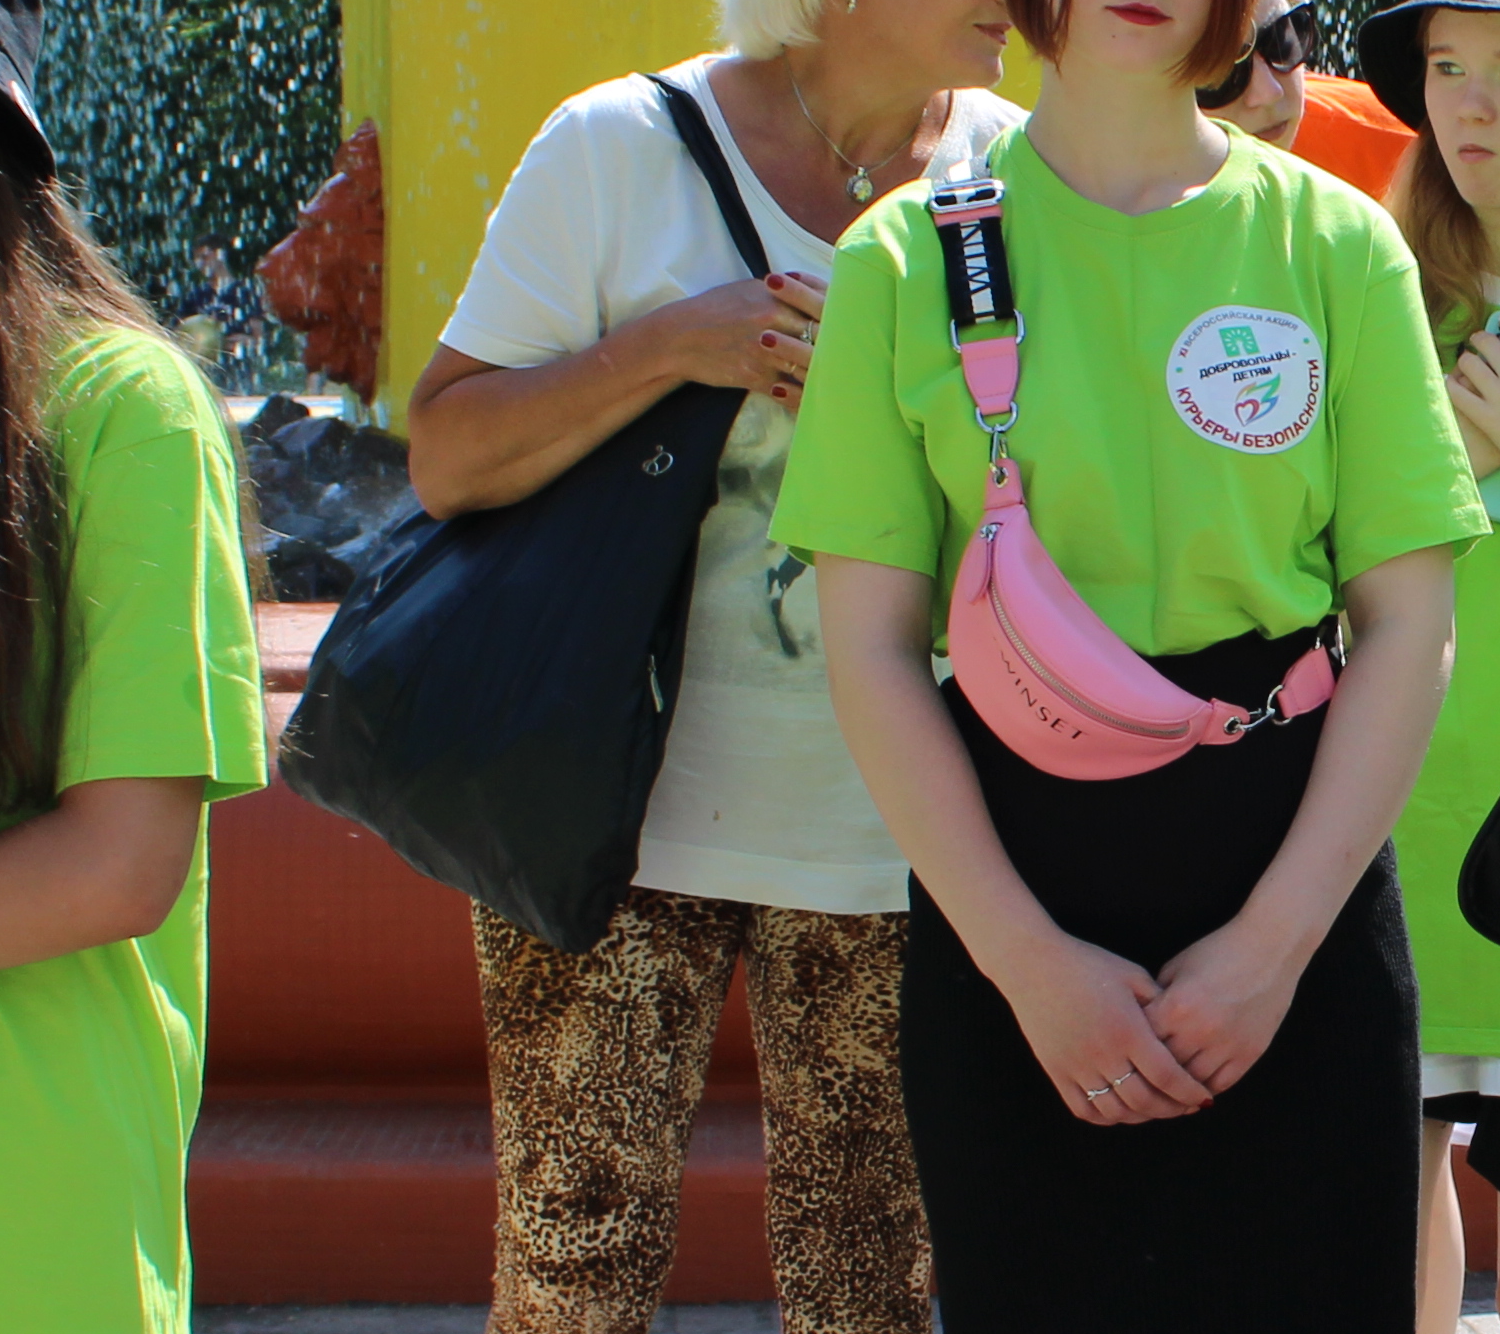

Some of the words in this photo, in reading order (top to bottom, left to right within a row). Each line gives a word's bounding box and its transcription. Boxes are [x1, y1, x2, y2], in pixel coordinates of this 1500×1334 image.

[1183, 310, 1263, 347] ВСЕРОССИЙСКАЯ
[1265, 316, 1299, 331] АКЦИЯ
[1199, 349, 1290, 380] ДОБРОВОЛЬЦЫ
[1233, 366, 1272, 383] ДЕТЯМ
[1176, 387, 1240, 444] КУРЬЕРЫ
[1242, 359, 1321, 448] БЕЗОПАСНОСТИ
